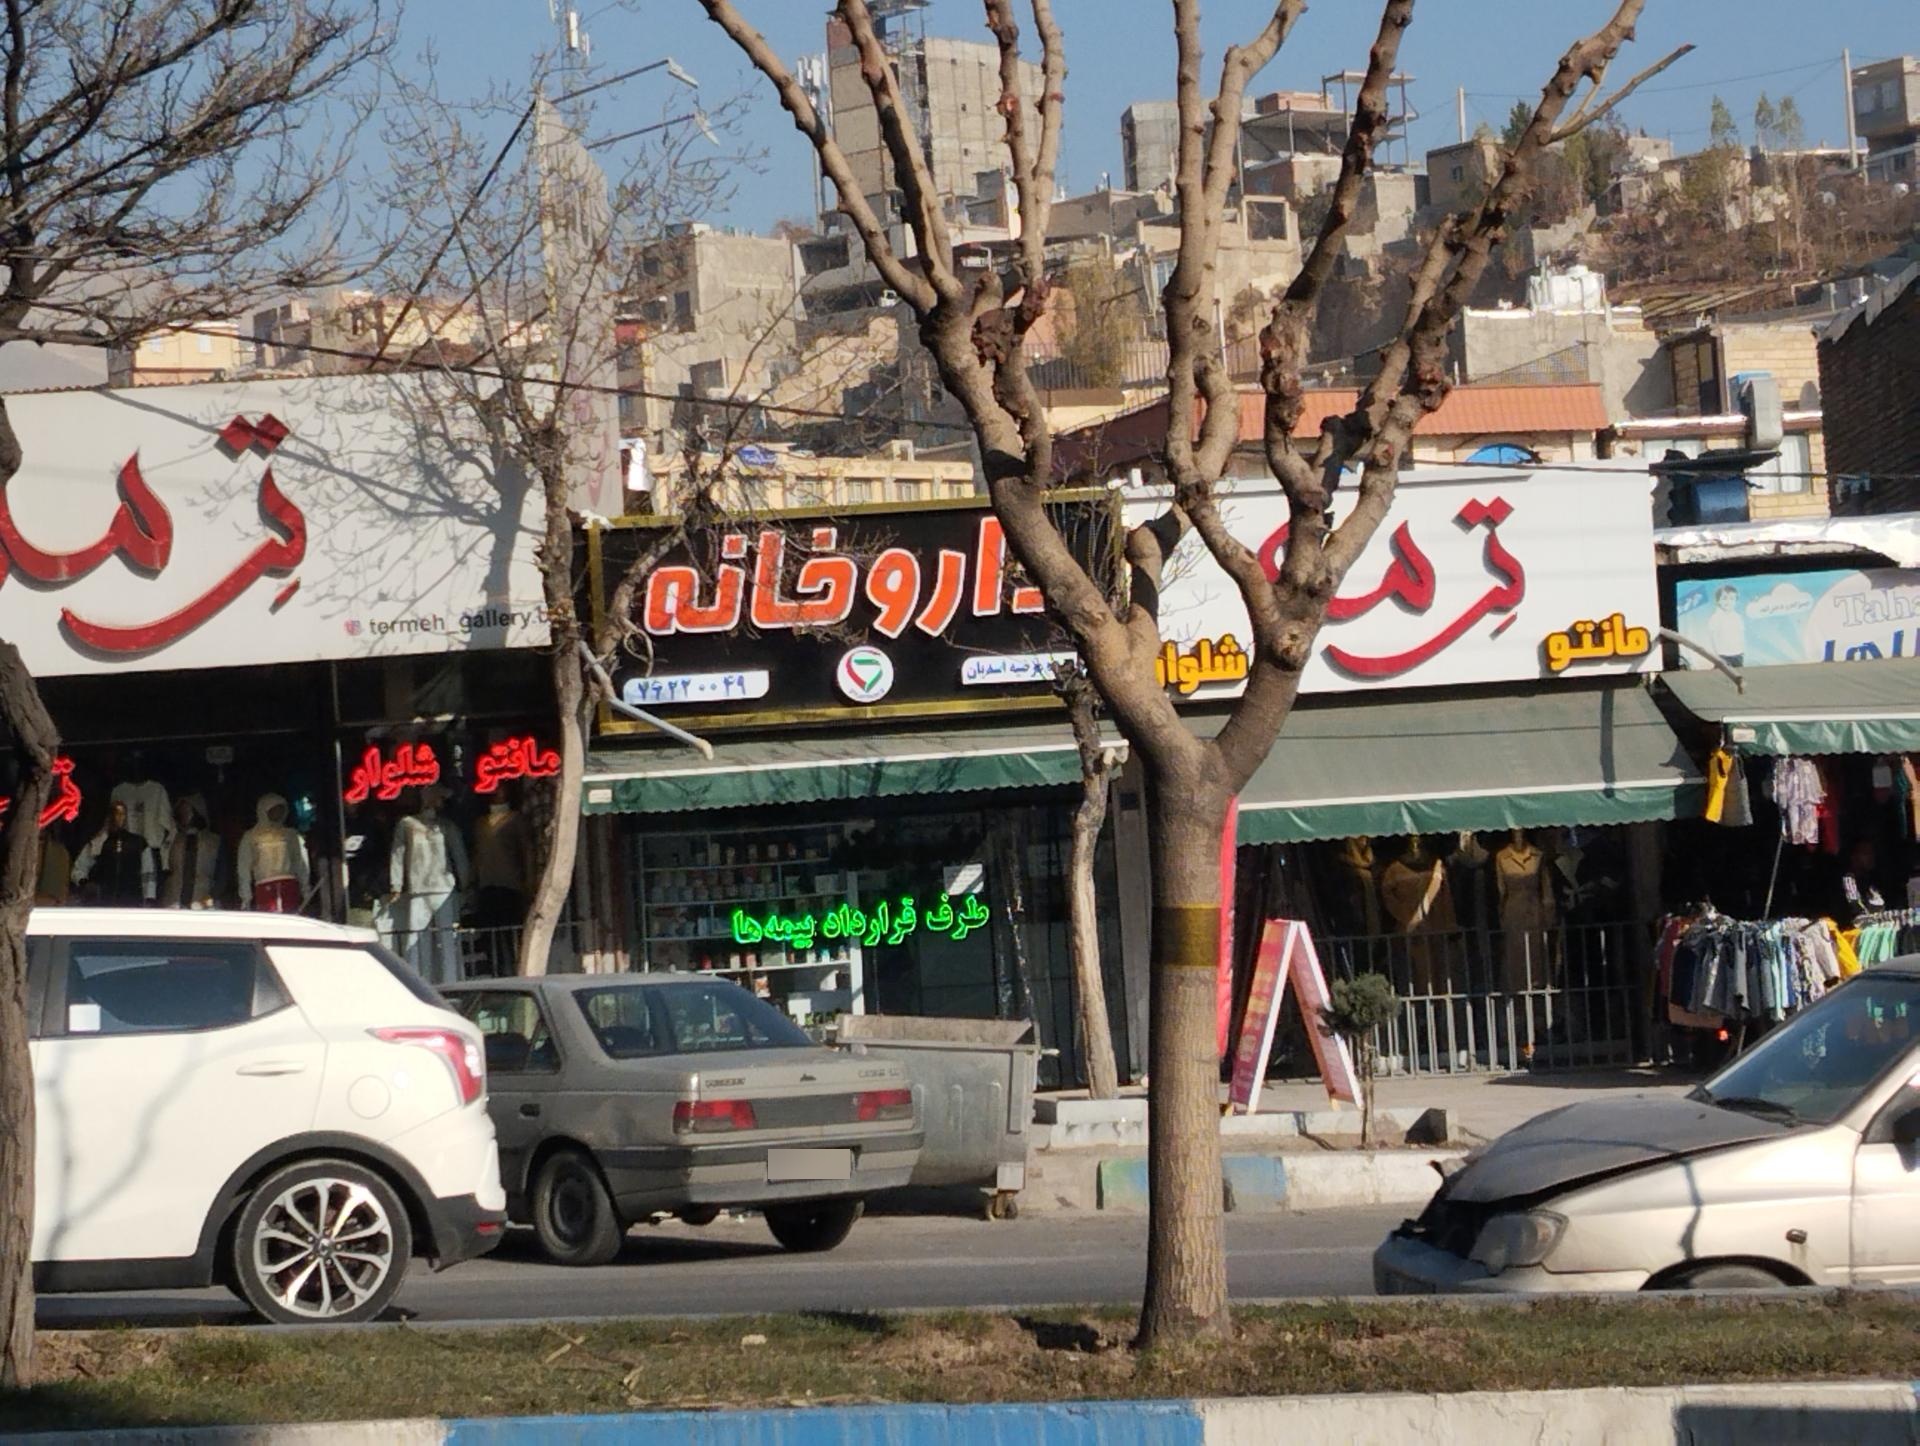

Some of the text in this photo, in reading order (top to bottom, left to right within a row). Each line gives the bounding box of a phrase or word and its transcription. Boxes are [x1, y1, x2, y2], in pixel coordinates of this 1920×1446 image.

[0, 413, 307, 652] ترم
[1543, 611, 1651, 673] مانتو
[474, 736, 561, 793] مانتو
[823, 896, 917, 947] قرارداد
[926, 893, 990, 940] طرف
